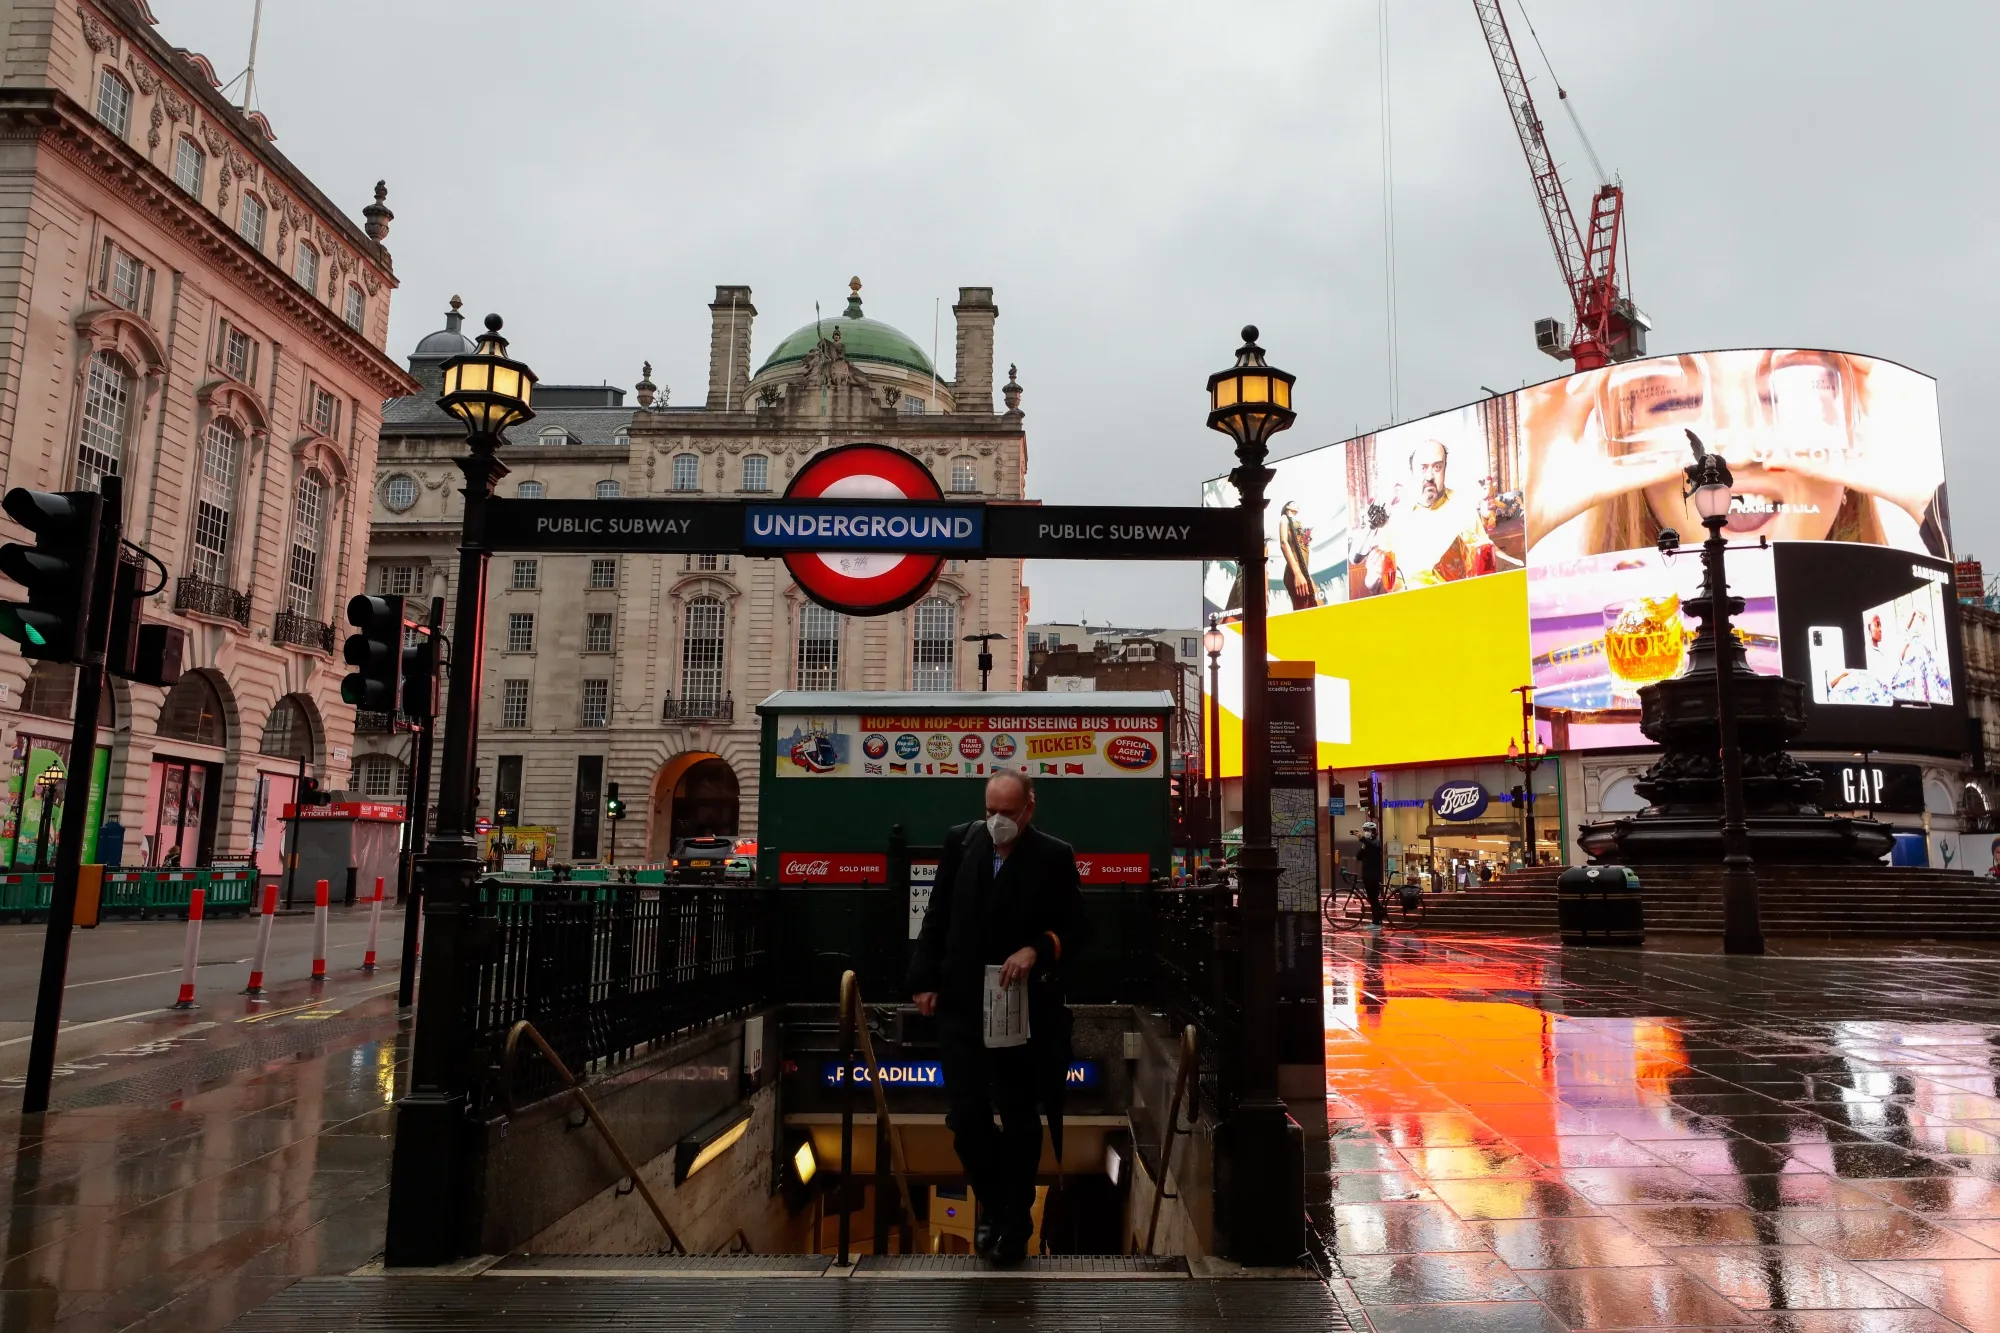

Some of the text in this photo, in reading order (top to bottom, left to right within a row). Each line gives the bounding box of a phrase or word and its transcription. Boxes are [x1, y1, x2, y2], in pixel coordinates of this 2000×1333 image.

[1737, 503, 1774, 514] NAME
[1793, 503, 1820, 514] LILA
[537, 517, 691, 535] PUBLIC SUBWAY
[753, 514, 974, 538] UNDERGROUND
[1038, 523, 1191, 541] PUBLIC SUBWAY
[1912, 564, 1949, 585] SAMSUNG
[867, 717, 1158, 729] HOP-ON HOP-OFF SIGHTSEEING BUS TOURS
[1029, 735, 1092, 754] TICKETS
[1115, 739, 1151, 750] OFFICIAL
[1118, 747, 1146, 757] AGENT
[1842, 768, 1884, 804] GAP
[1437, 786, 1480, 815] Boots
[785, 859, 880, 877] Coca-Cola SOLD HERE
